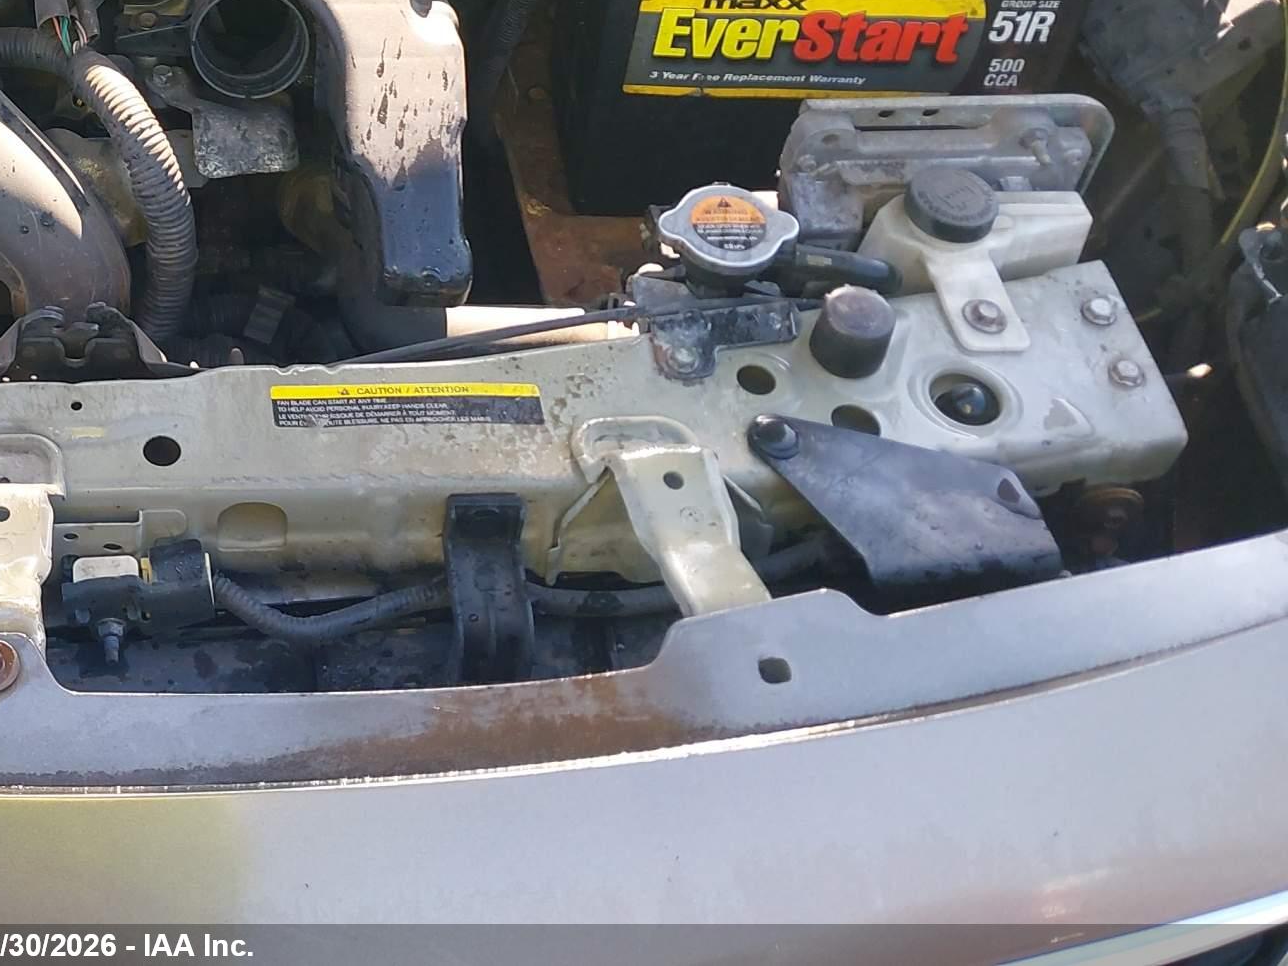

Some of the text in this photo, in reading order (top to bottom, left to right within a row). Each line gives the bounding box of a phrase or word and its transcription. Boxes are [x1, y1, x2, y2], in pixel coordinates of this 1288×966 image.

[1001, 0, 1036, 8] GROUP
[988, 10, 1056, 43] 51R
[652, 6, 969, 65] EverStart
[988, 58, 1025, 73] 500
[649, 70, 658, 79] 3
[661, 71, 689, 80] Year
[723, 73, 805, 83] Replacement
[809, 74, 866, 86] Warranty
[983, 73, 1018, 87] CCA
[356, 387, 402, 395] CAUTION
[413, 385, 469, 394] ATTENTION
